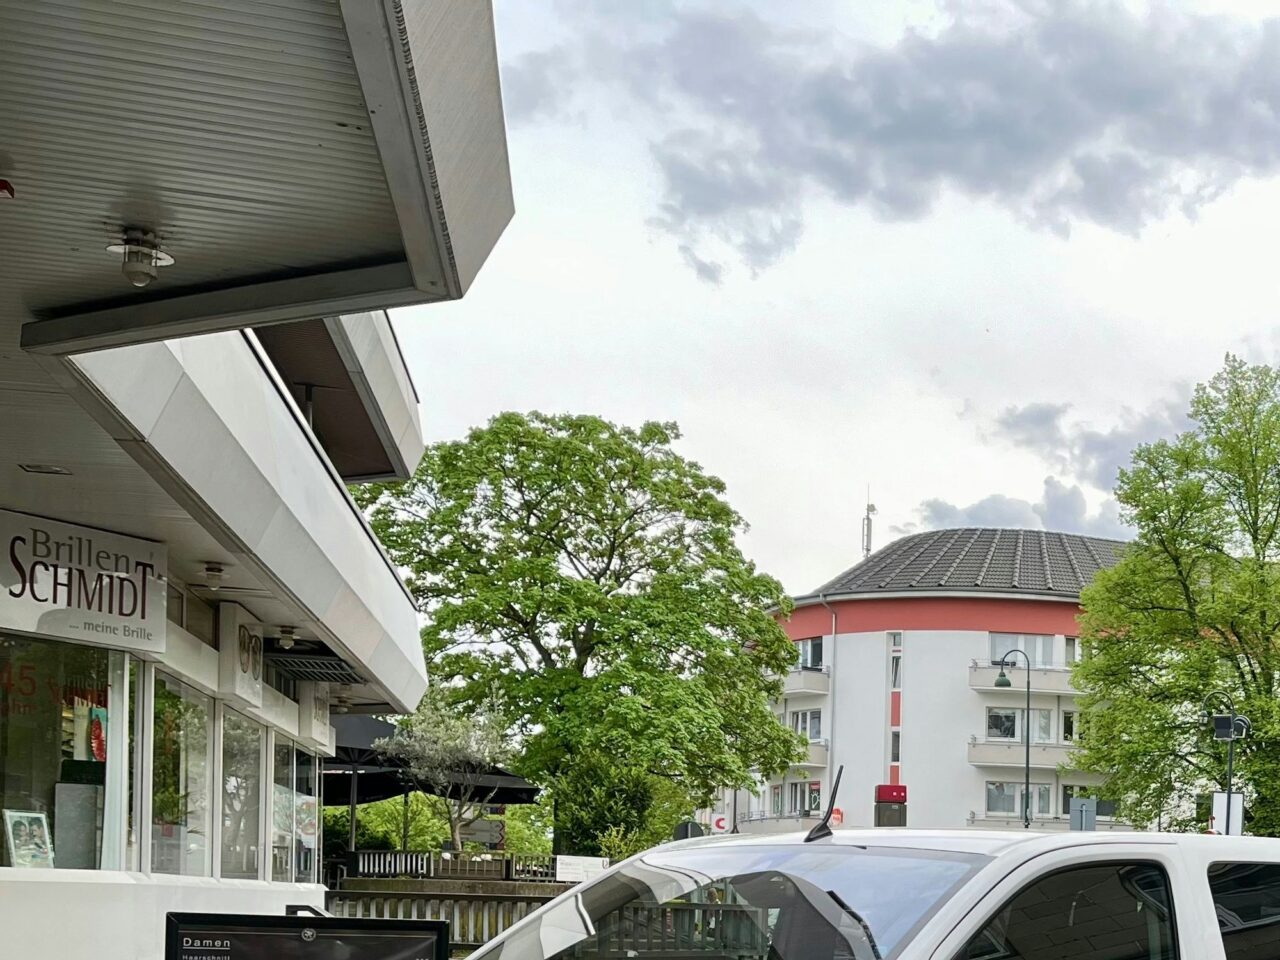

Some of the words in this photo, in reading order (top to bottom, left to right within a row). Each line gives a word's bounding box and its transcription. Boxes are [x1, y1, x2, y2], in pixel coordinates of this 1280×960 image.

[29, 527, 130, 574] Brillen
[8, 535, 155, 620] SCHMIDT
[83, 620, 119, 636] meine
[122, 624, 153, 641] Brille
[183, 937, 230, 947] Damen
